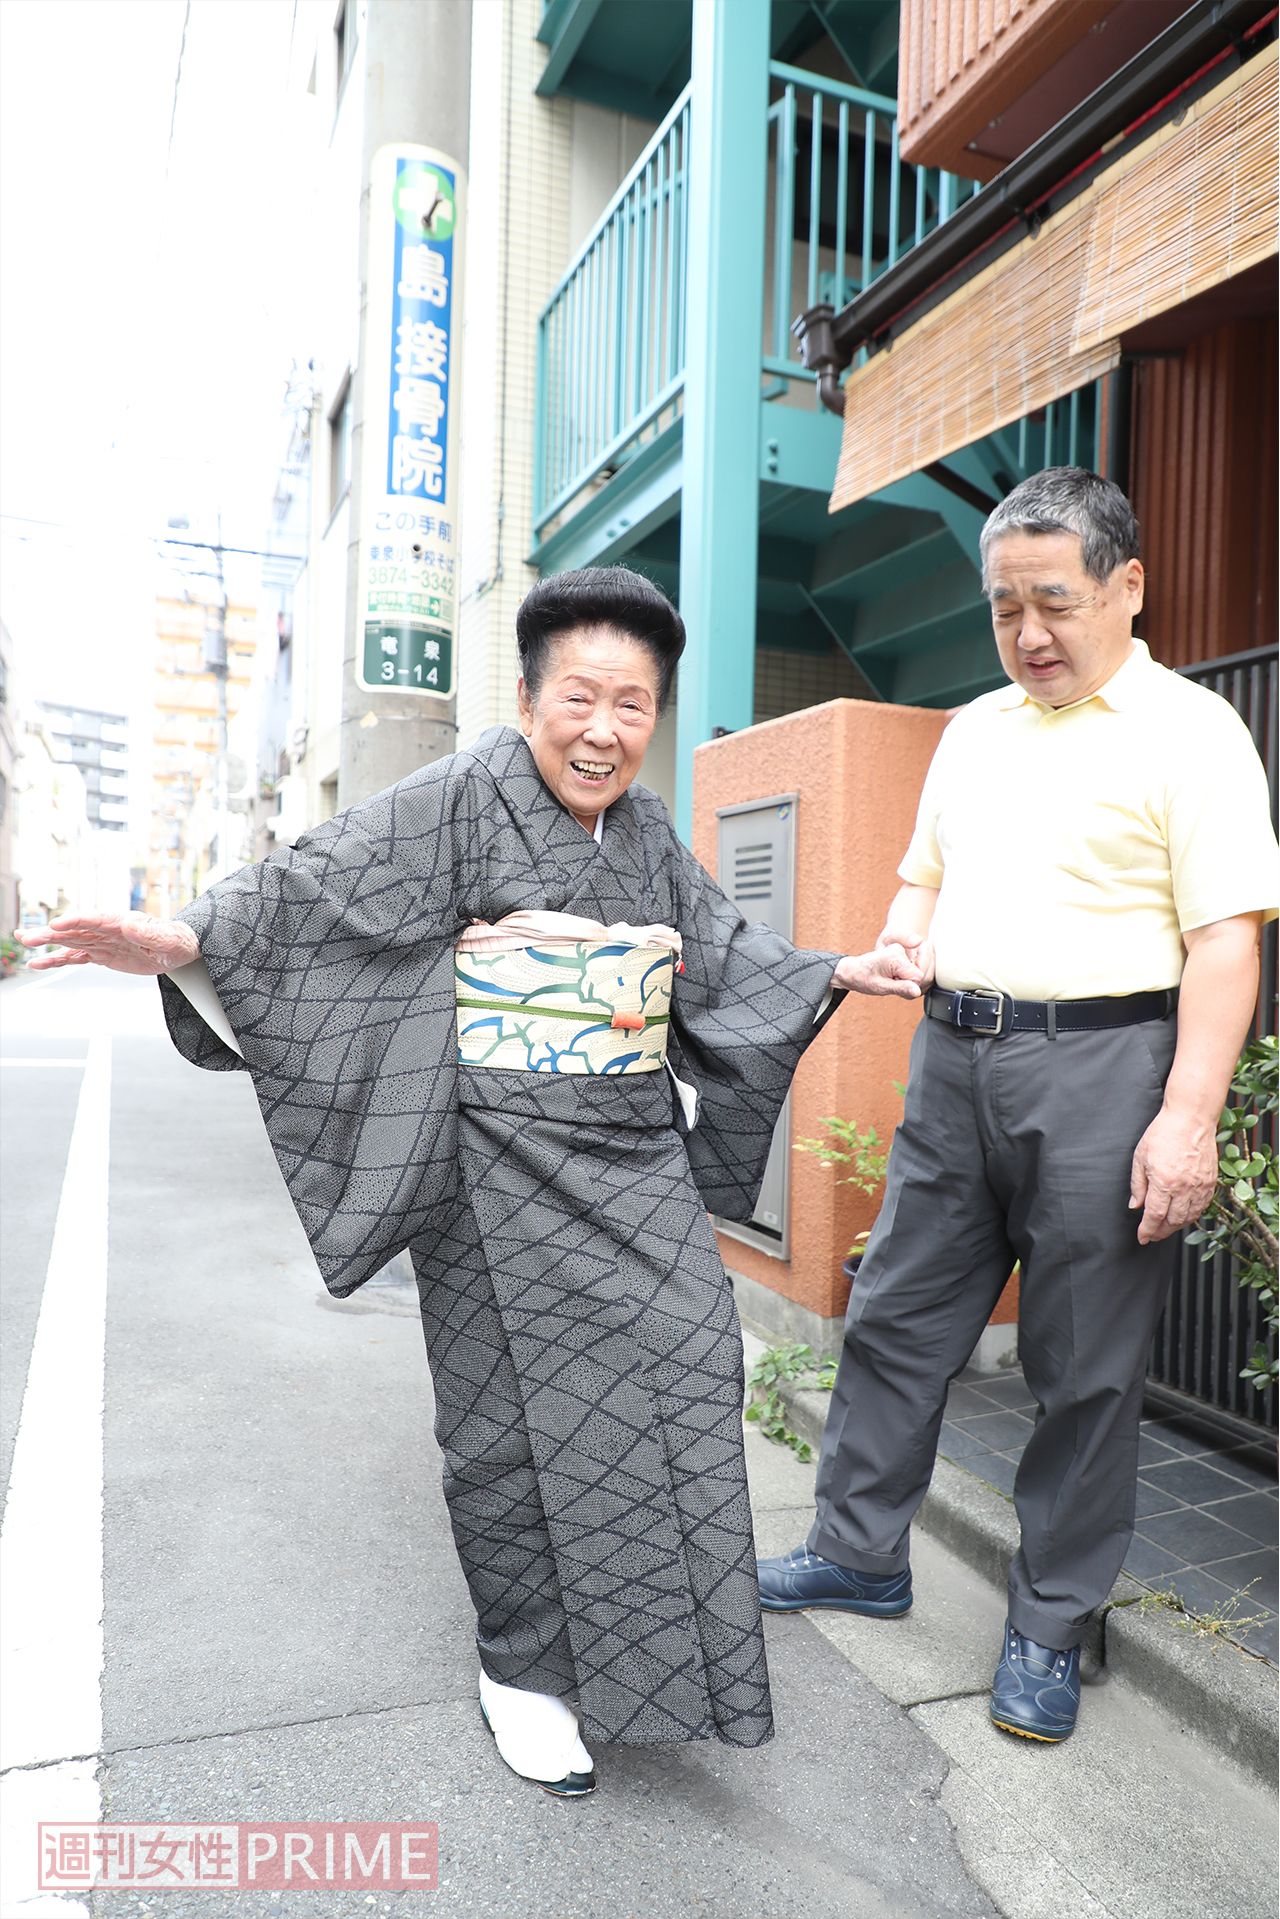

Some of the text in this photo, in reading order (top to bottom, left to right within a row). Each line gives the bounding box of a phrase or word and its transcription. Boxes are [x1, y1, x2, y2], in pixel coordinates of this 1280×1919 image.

[375, 512, 452, 543] この手前
[368, 566, 455, 596] 3874-3342
[381, 661, 438, 686] 3-14
